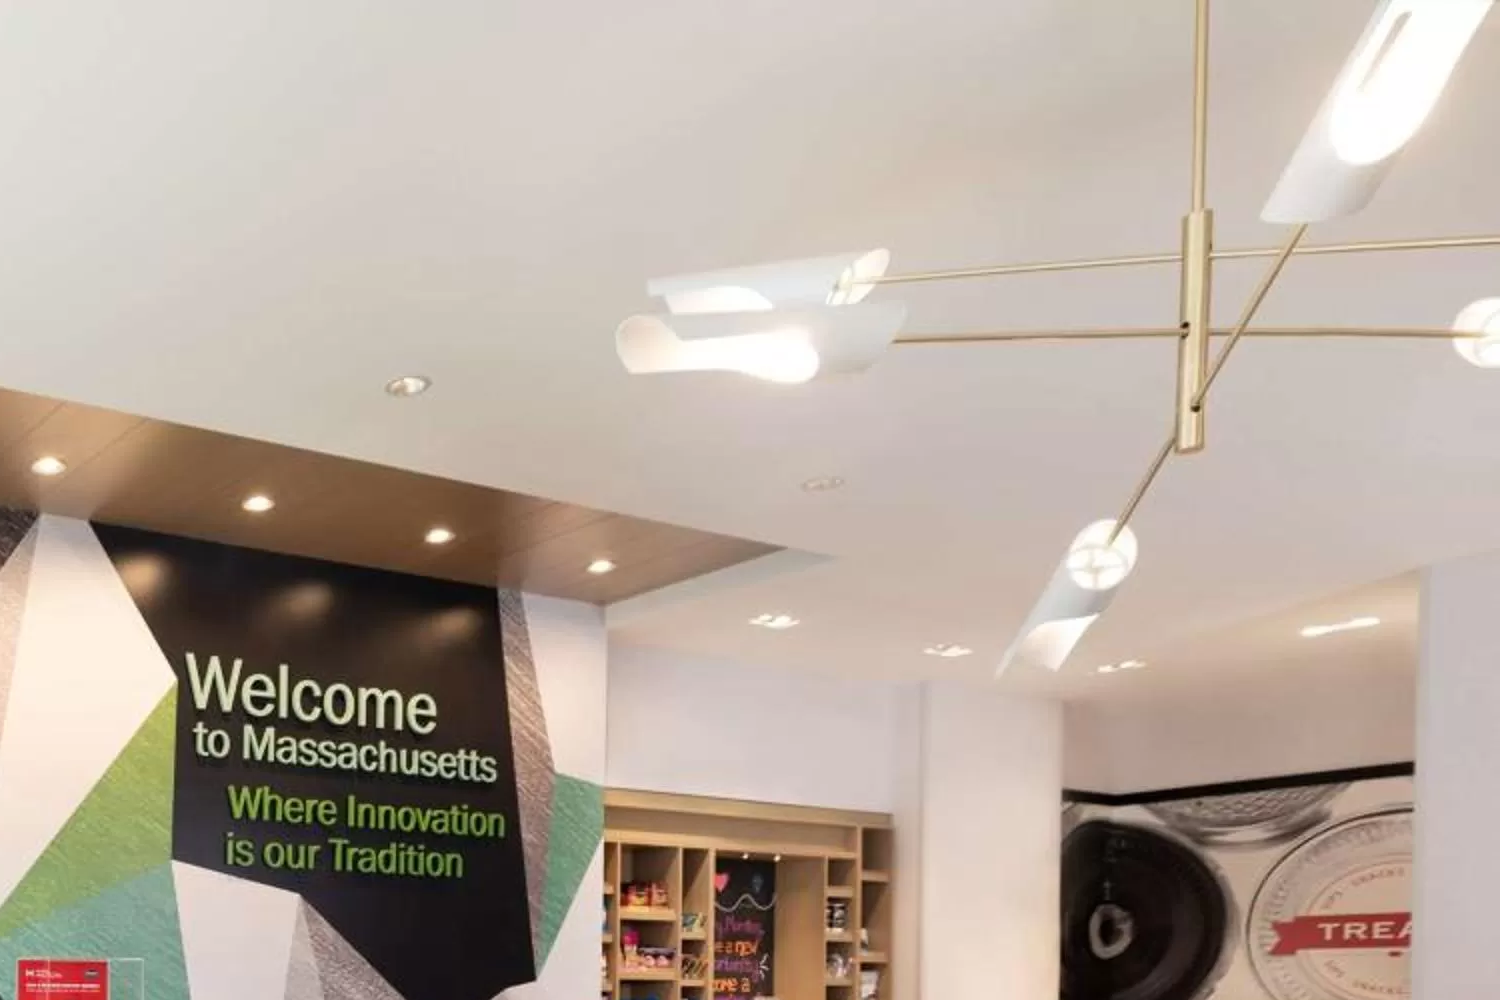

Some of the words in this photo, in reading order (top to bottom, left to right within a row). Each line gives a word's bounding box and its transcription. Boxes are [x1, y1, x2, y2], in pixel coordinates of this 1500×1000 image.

[185, 652, 438, 736] Welcome
[193, 721, 231, 759] to
[242, 723, 498, 784] Massachusetts
[228, 785, 337, 826] Where
[348, 795, 505, 838] Innovation
[226, 832, 254, 866] is
[263, 840, 320, 870] our
[328, 838, 464, 878] Tradition
